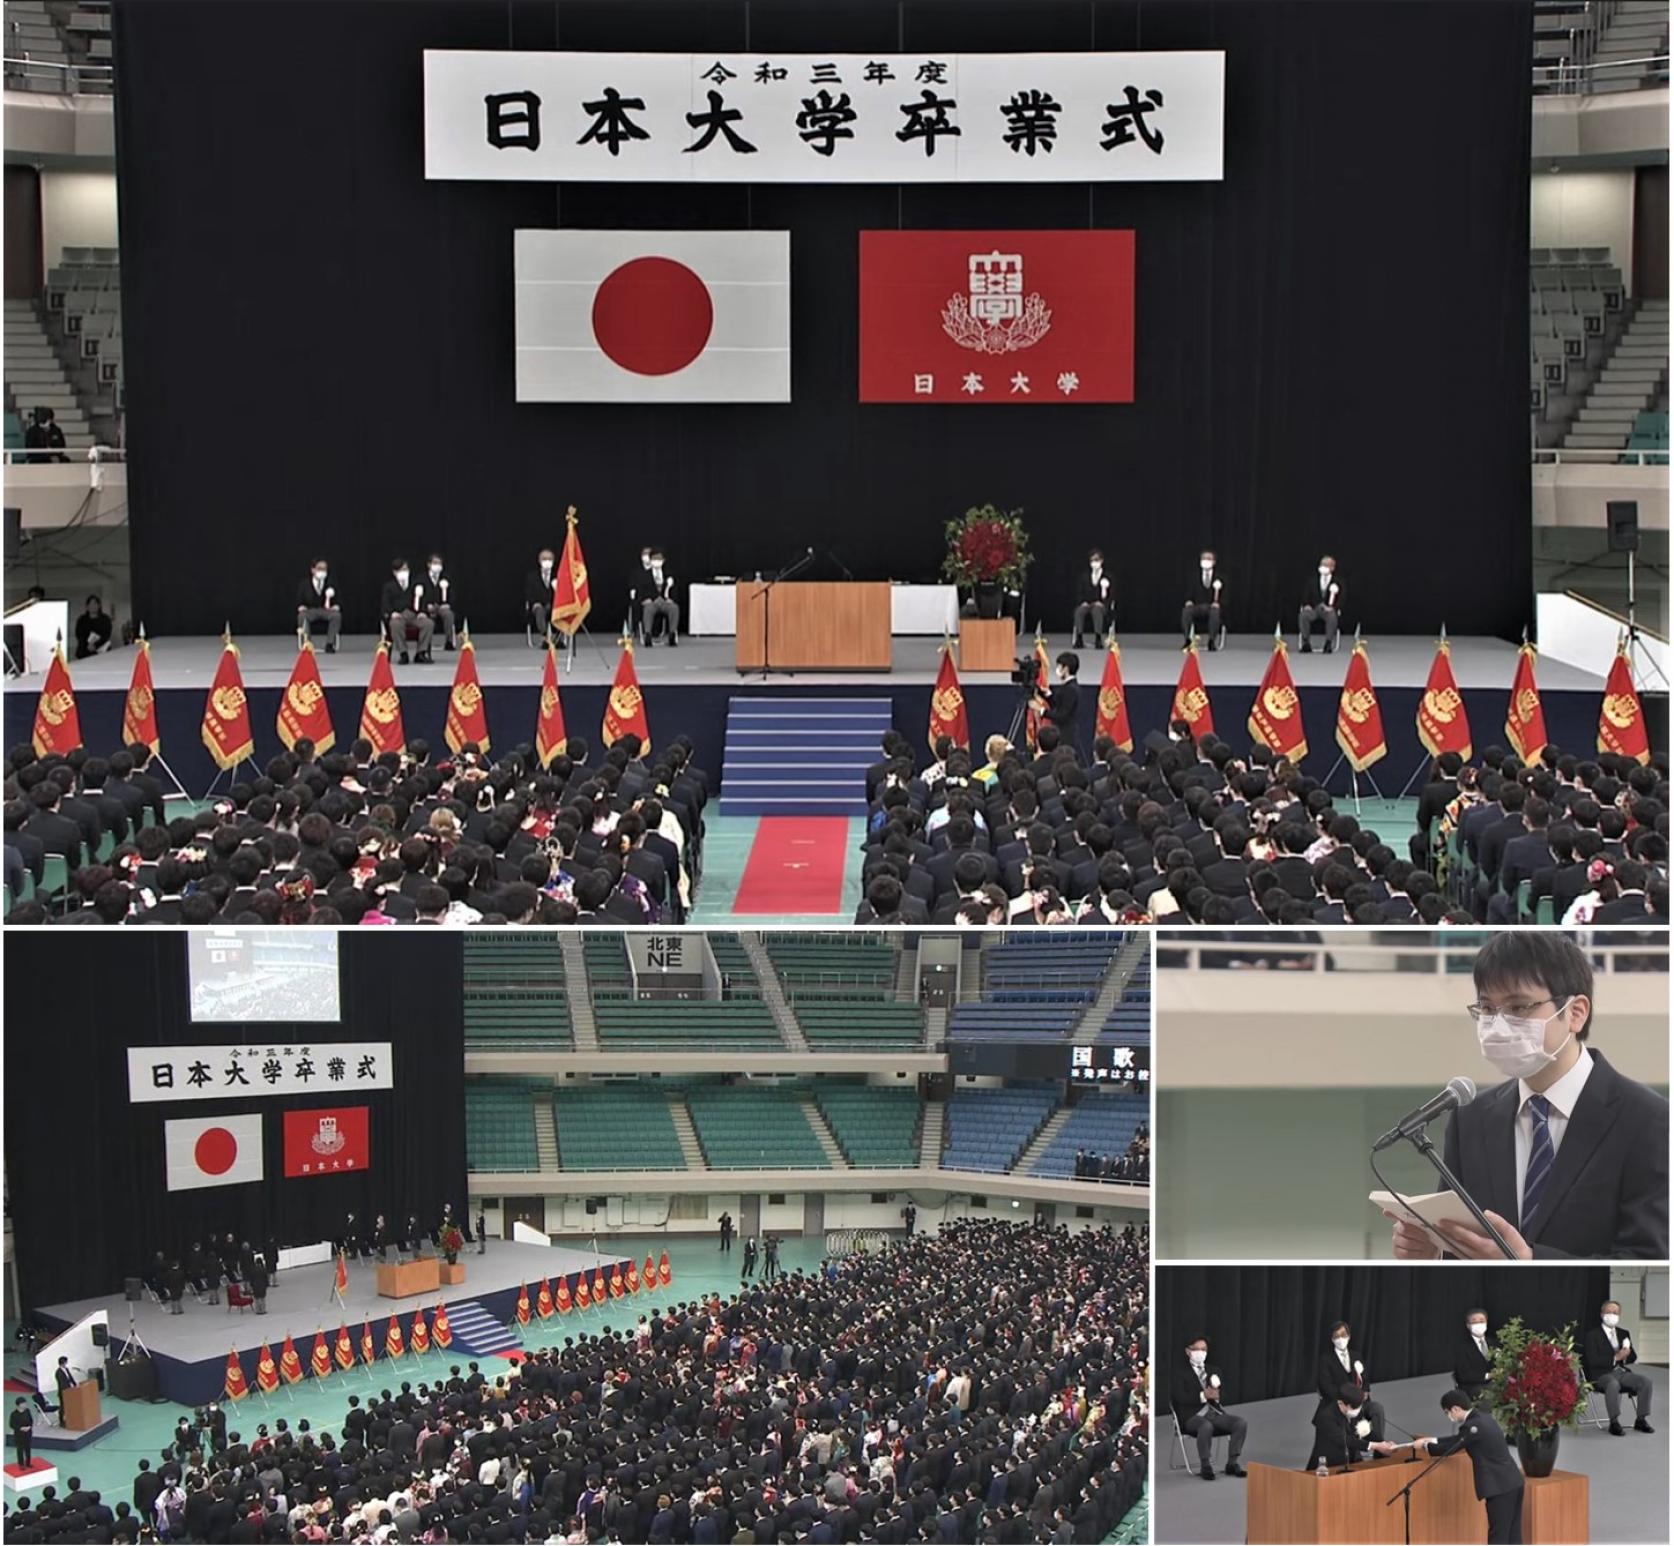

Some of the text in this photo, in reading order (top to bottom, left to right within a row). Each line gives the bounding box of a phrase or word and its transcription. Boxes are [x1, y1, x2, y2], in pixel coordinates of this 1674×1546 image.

[700, 60, 949, 85] 令和三年度
[484, 86, 1165, 157] 日本大学卒業式
[914, 371, 1080, 395] 日本大学
[647, 936, 683, 951] 北東
[647, 952, 683, 967] NE
[229, 1046, 312, 1058] 令和三年度
[1072, 1046, 1135, 1068] 国歌
[151, 1054, 377, 1089] 日本大学卒業式
[302, 1159, 354, 1173] 日本大学
